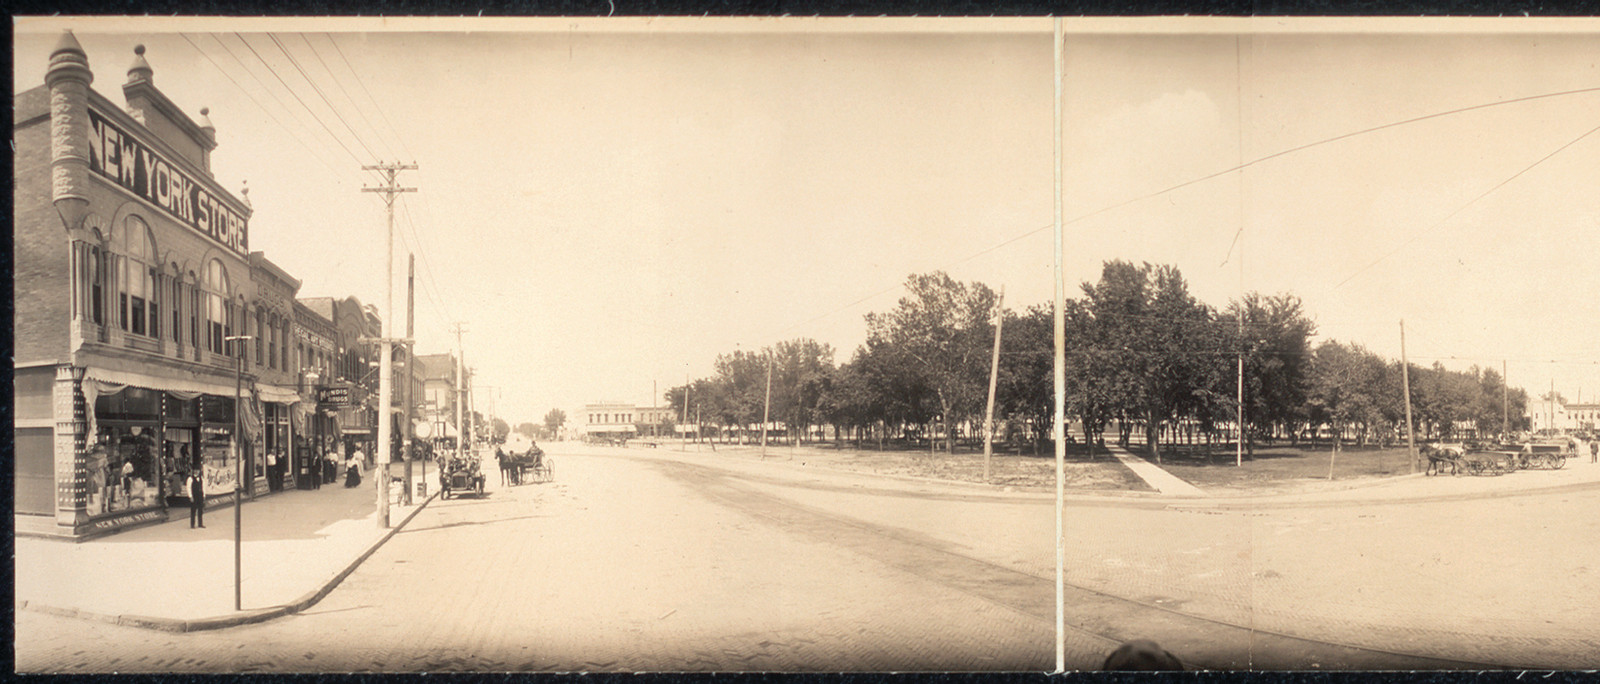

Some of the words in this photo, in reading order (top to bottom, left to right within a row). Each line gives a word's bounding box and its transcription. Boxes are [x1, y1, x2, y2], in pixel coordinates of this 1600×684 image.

[88, 114, 137, 188] NEW
[141, 148, 194, 224] YORK
[258, 284, 284, 308] DRUGS
[320, 389, 348, 401] MUNDIS
[96, 519, 114, 529] NEW
[114, 515, 134, 527] YORK
